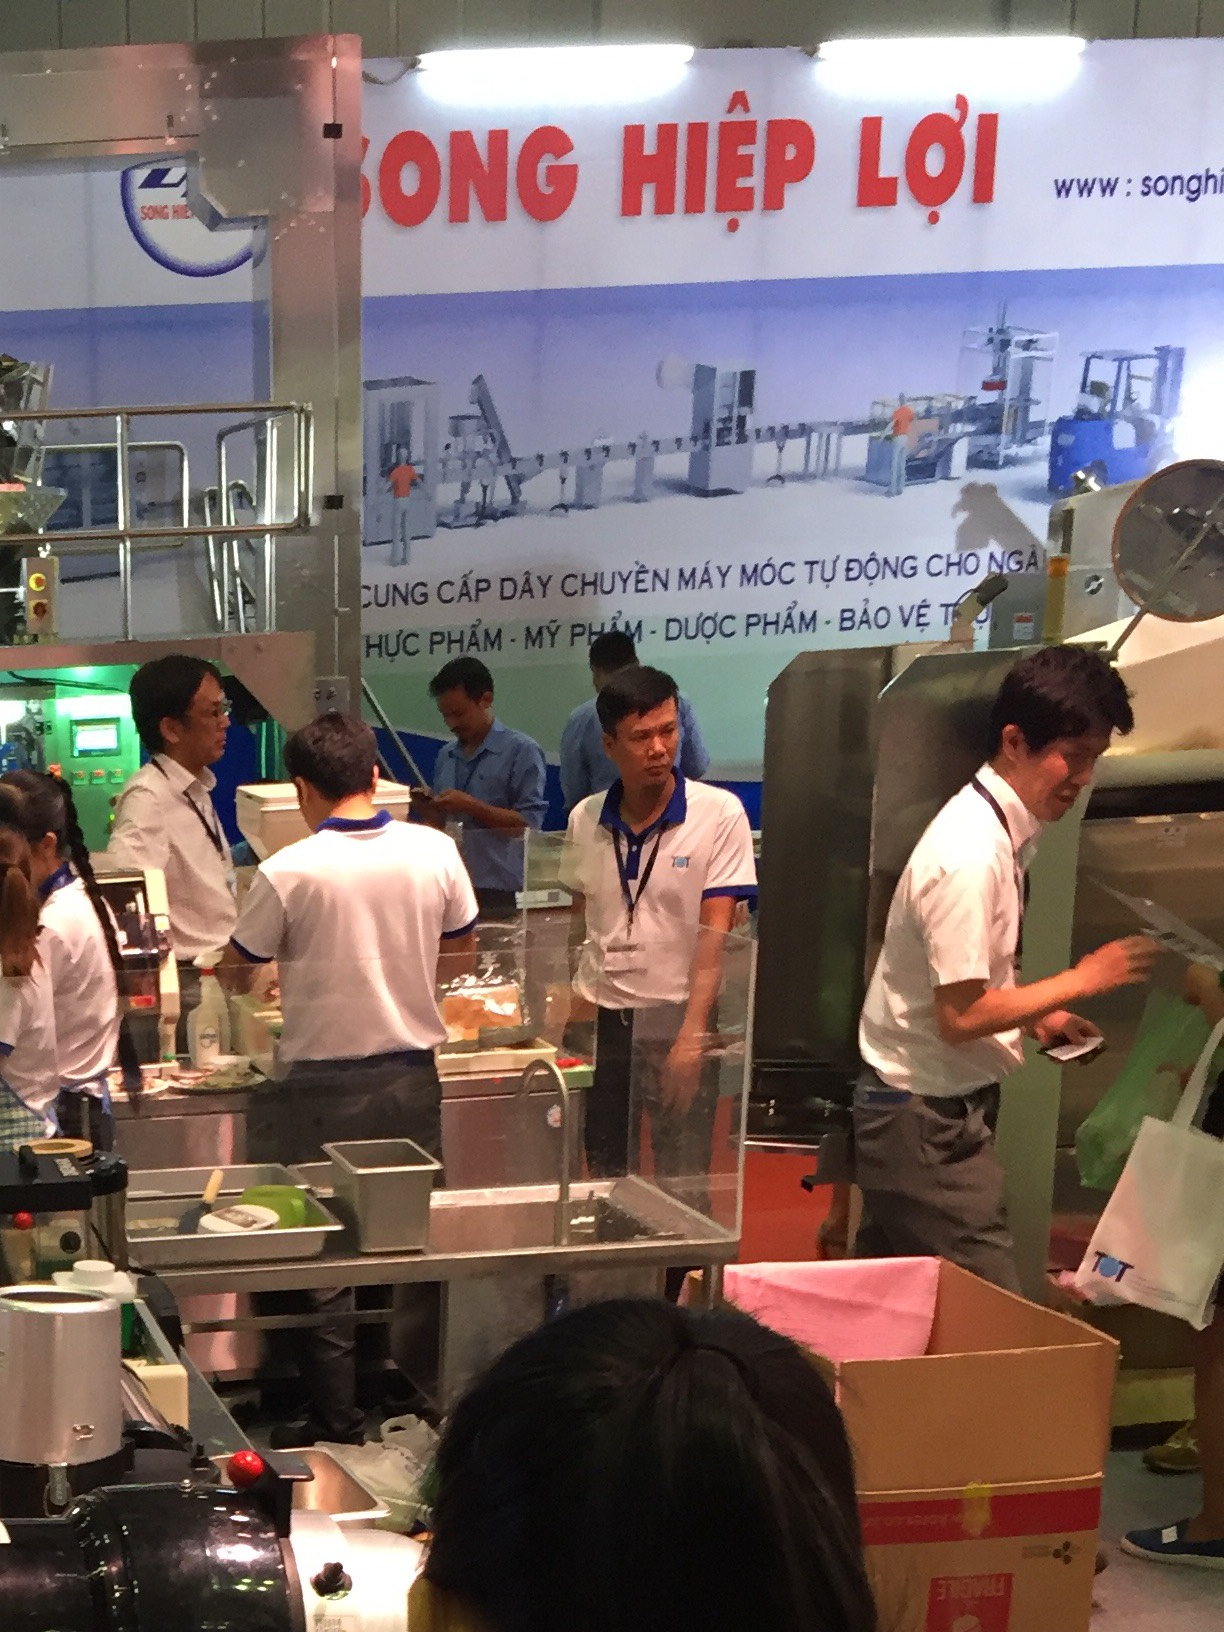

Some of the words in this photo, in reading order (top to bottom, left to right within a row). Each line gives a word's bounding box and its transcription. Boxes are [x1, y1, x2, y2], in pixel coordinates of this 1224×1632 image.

[620, 90, 816, 234] HIỆP
[856, 93, 1000, 226] LỢI
[1054, 176, 1120, 199] www
[437, 569, 491, 604] CẤP
[500, 569, 552, 600] DÂY
[561, 560, 670, 597] CHUYỀN
[678, 561, 733, 591] MÁY
[739, 556, 795, 586] MÓC
[803, 555, 842, 590] TỰ
[845, 550, 918, 583] ĐỘNG
[925, 552, 980, 578] CHO
[987, 544, 1047, 575] NGÀ
[363, 629, 420, 663] HỰC
[429, 619, 503, 656] PHẨM
[525, 618, 562, 650] MỸ
[664, 611, 737, 645] DƯỢC
[745, 602, 818, 636] PHẨM
[839, 598, 891, 631] BẢO
[900, 598, 932, 633] VỆ
[1092, 1250, 1135, 1283] TOT
[937, 1576, 1006, 1600] FRAGILE
